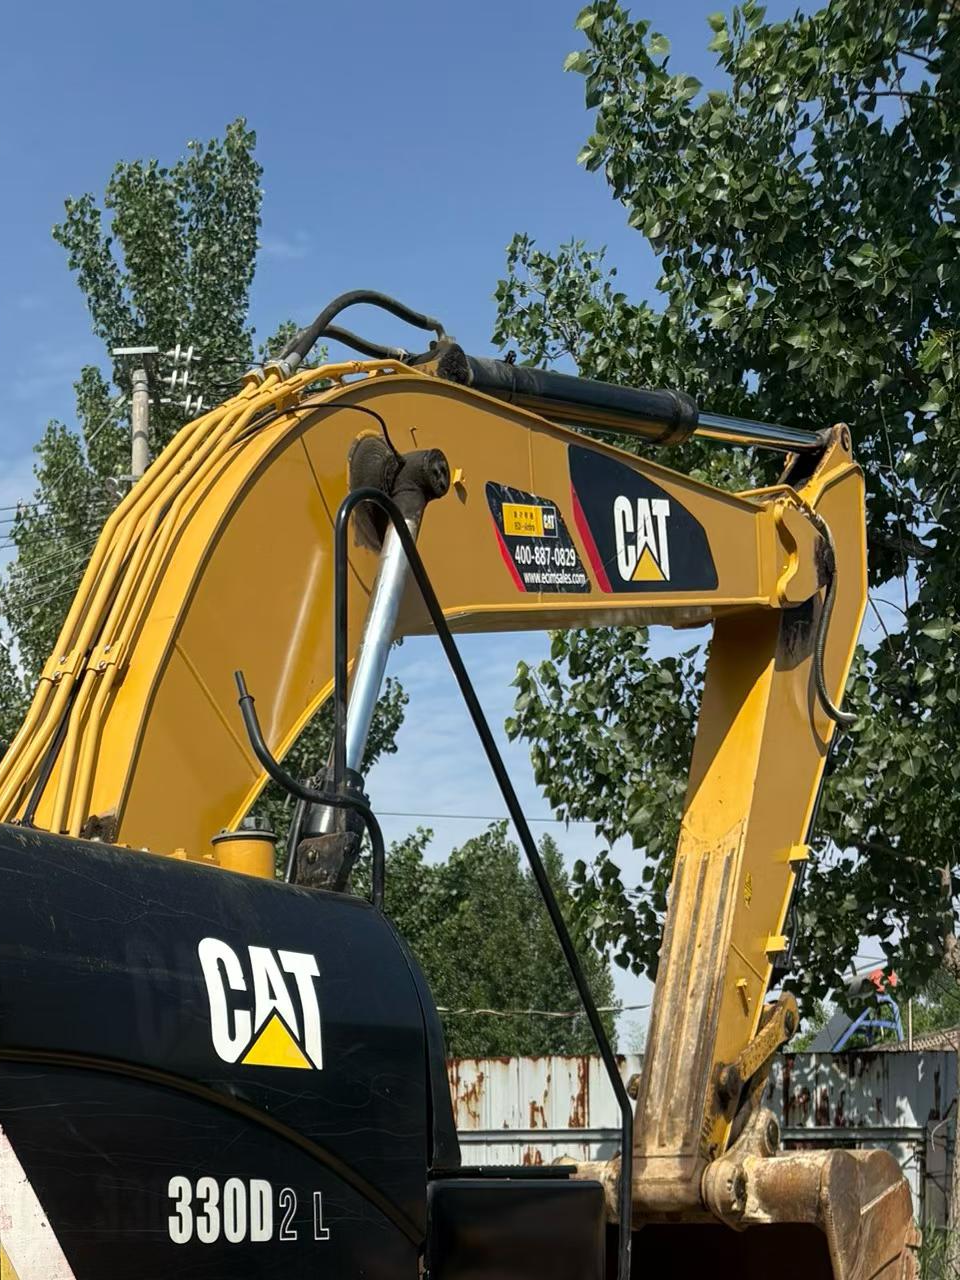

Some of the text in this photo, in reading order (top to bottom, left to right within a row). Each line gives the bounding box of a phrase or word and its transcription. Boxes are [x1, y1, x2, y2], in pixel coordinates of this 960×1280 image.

[543, 514, 555, 530] CAT
[613, 496, 671, 581] CAT
[514, 544, 576, 567] 400-887-0829
[197, 937, 324, 1071] CAT
[313, 1191, 330, 1241] L
